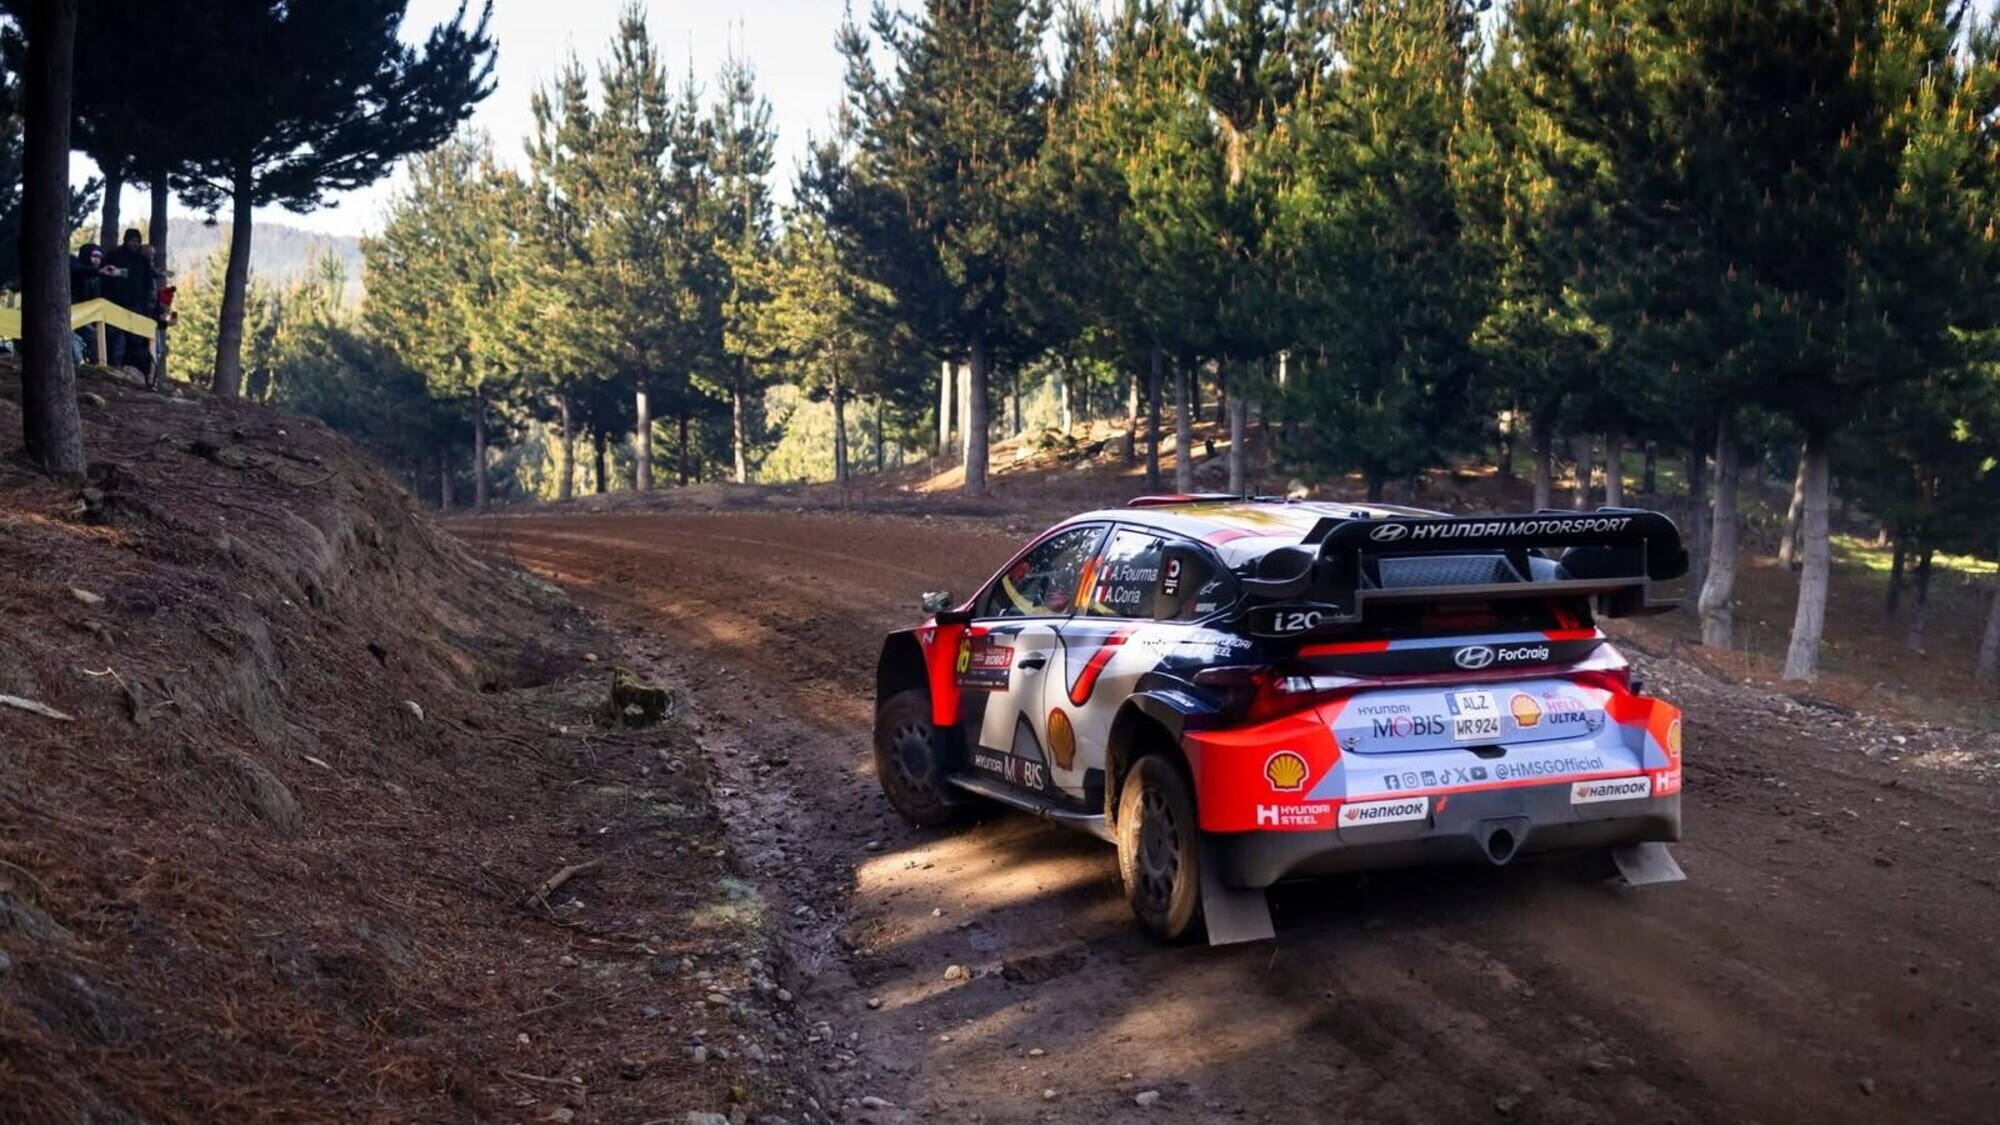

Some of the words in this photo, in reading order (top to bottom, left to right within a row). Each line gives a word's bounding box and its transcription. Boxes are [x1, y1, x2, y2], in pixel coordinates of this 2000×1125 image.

[1411, 522, 1510, 539] HYUNDAI
[1509, 517, 1632, 536] MOTORSPORT
[1274, 611, 1322, 631] i20
[1498, 646, 1549, 661] ForCraig
[1358, 705, 1411, 716] HYUNDAI
[1463, 695, 1489, 710] ALZ
[1549, 712, 1586, 724] ULTRA
[1373, 715, 1445, 738] MOBIS
[1456, 720, 1473, 735] WR
[1476, 718, 1498, 734] 924
[1495, 757, 1604, 780] @HMSGOfficial
[1280, 814, 1318, 826] STEEL
